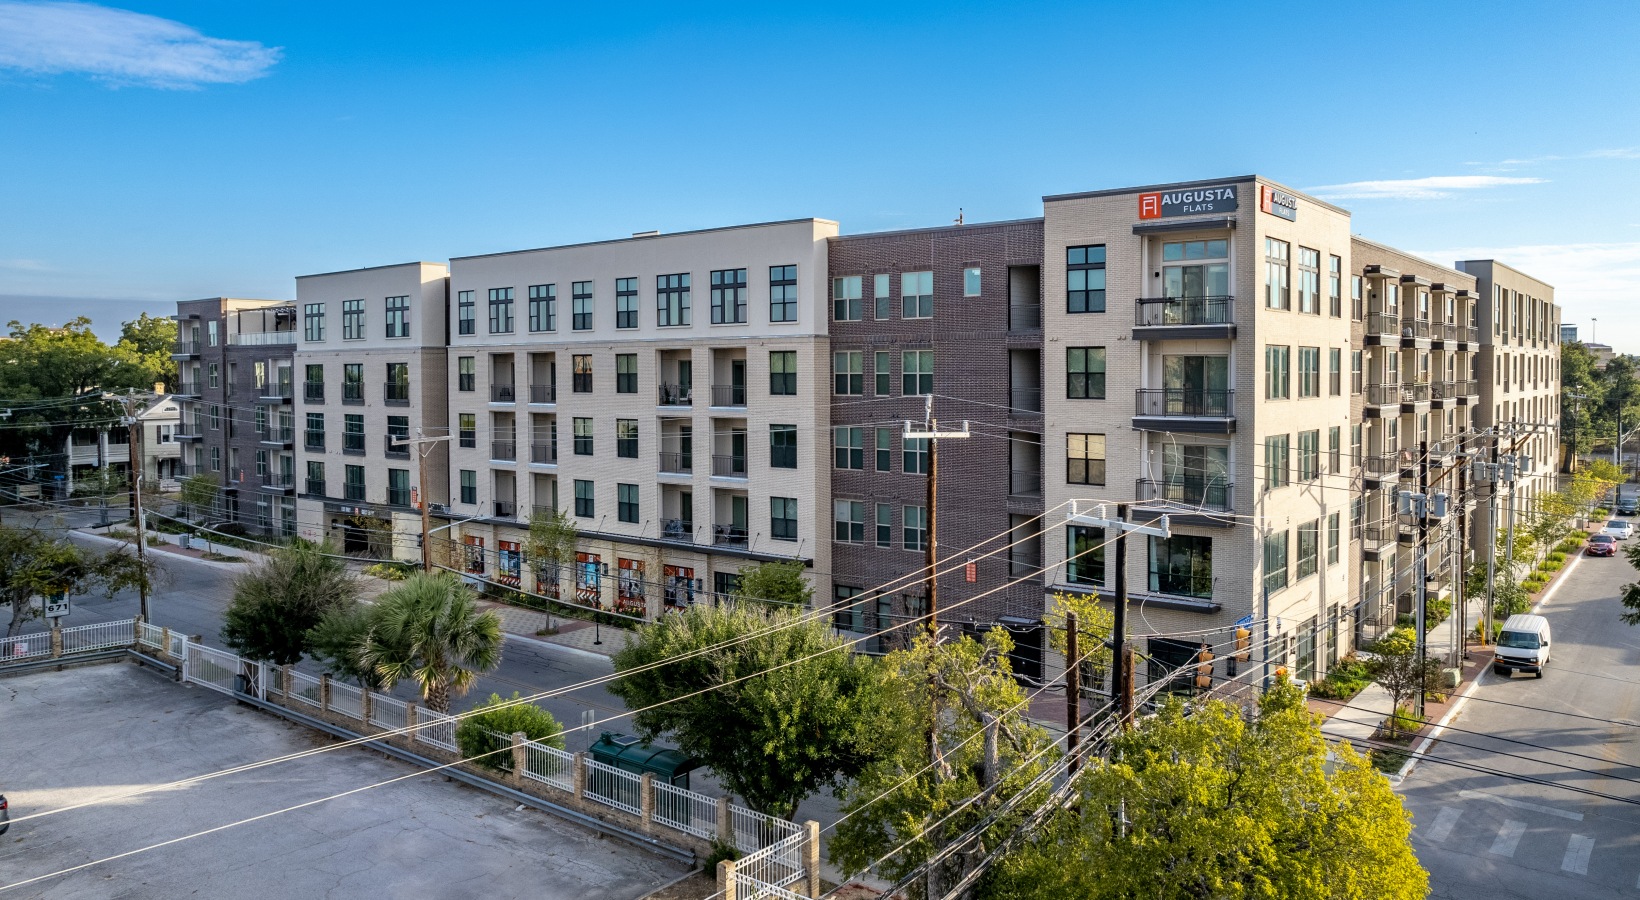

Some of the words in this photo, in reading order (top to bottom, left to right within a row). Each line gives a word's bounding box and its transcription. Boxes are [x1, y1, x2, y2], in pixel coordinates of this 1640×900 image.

[1162, 188, 1234, 206] AUGUSTA
[1273, 192, 1297, 209] AUGUST
[1183, 203, 1213, 213] FLATS
[48, 603, 68, 612] 671
